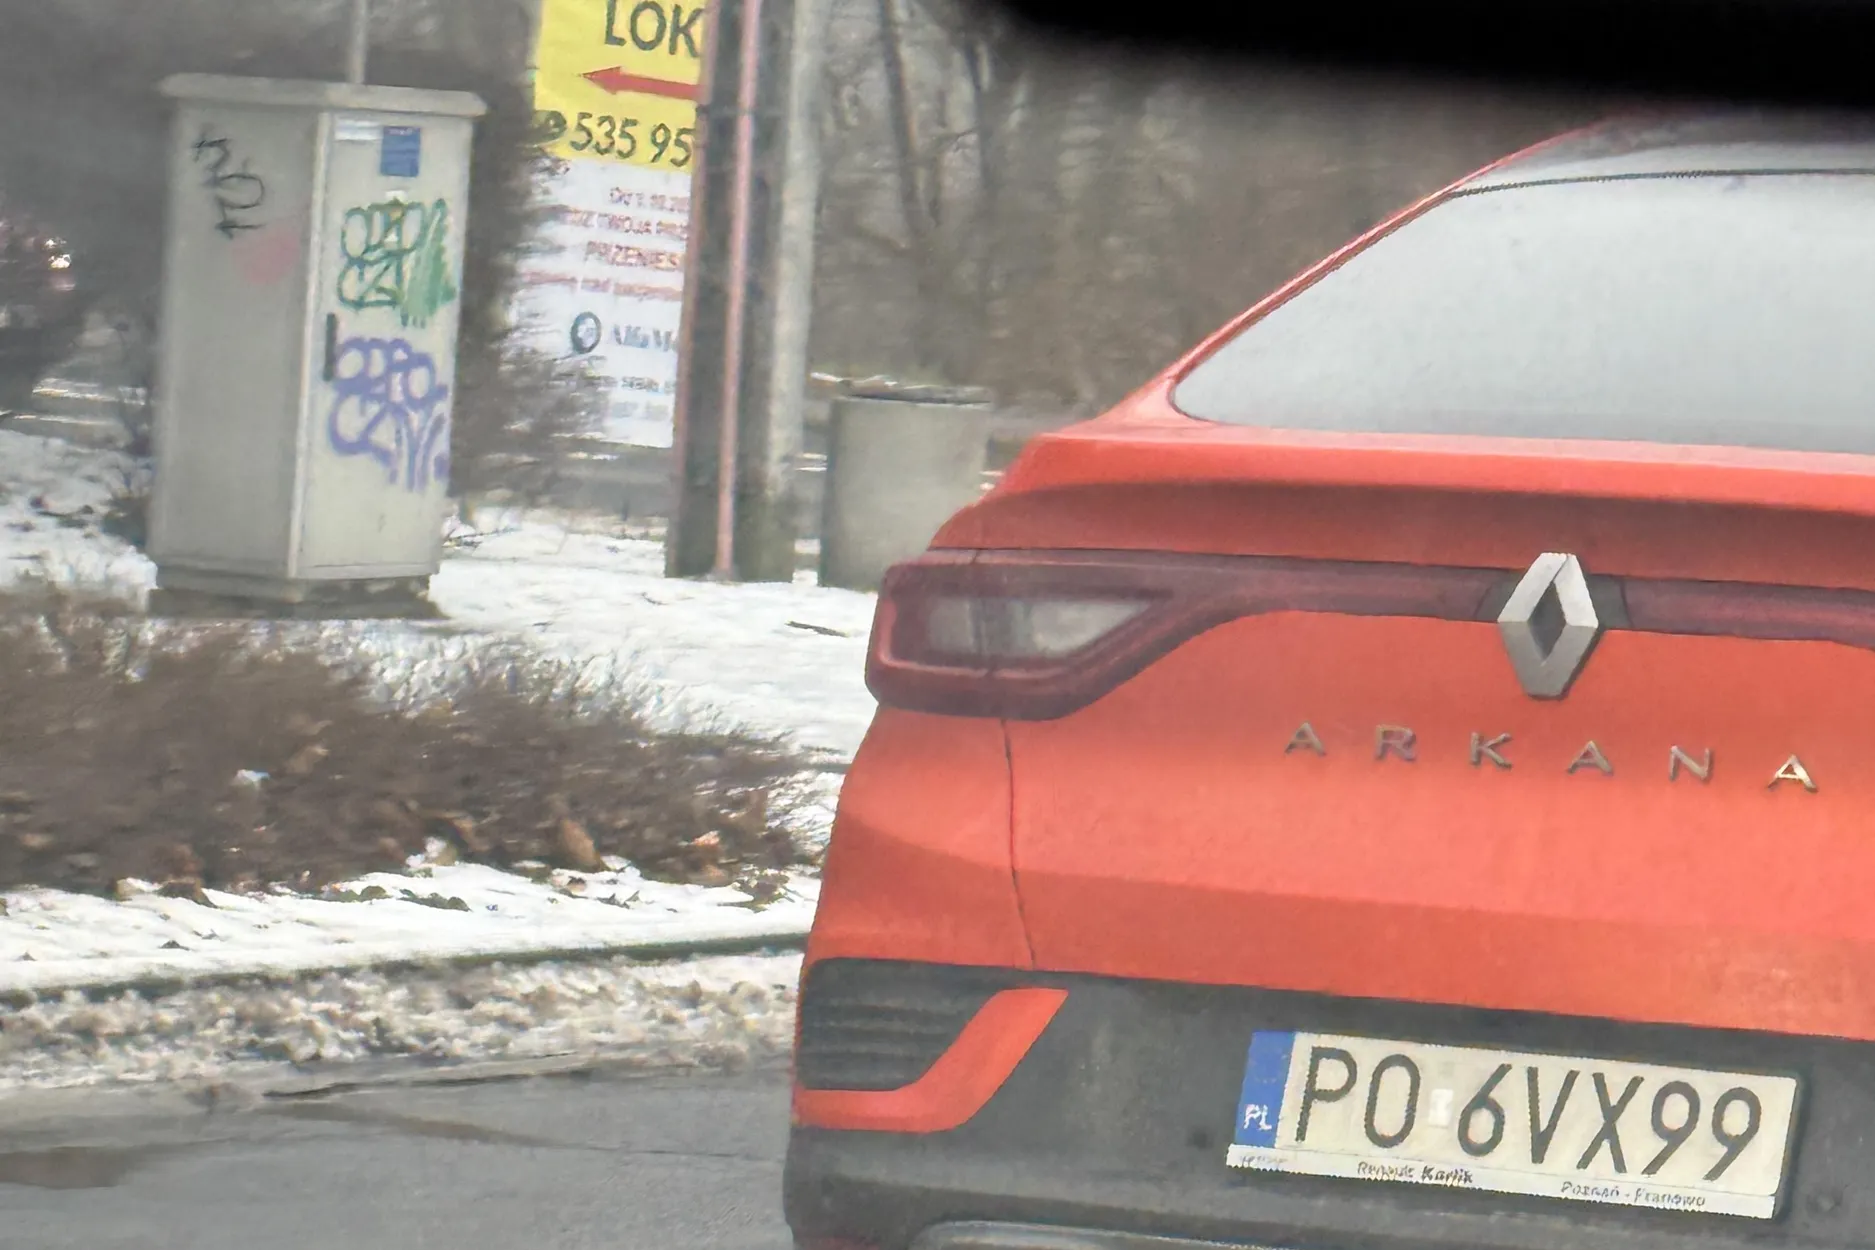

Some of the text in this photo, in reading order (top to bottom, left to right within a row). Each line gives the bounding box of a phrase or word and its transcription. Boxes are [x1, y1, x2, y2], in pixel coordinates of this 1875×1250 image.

[1284, 721, 1819, 794] ARKANA
[1243, 1103, 1273, 1131] PL
[1294, 1045, 1762, 1182] PO 6VX99
